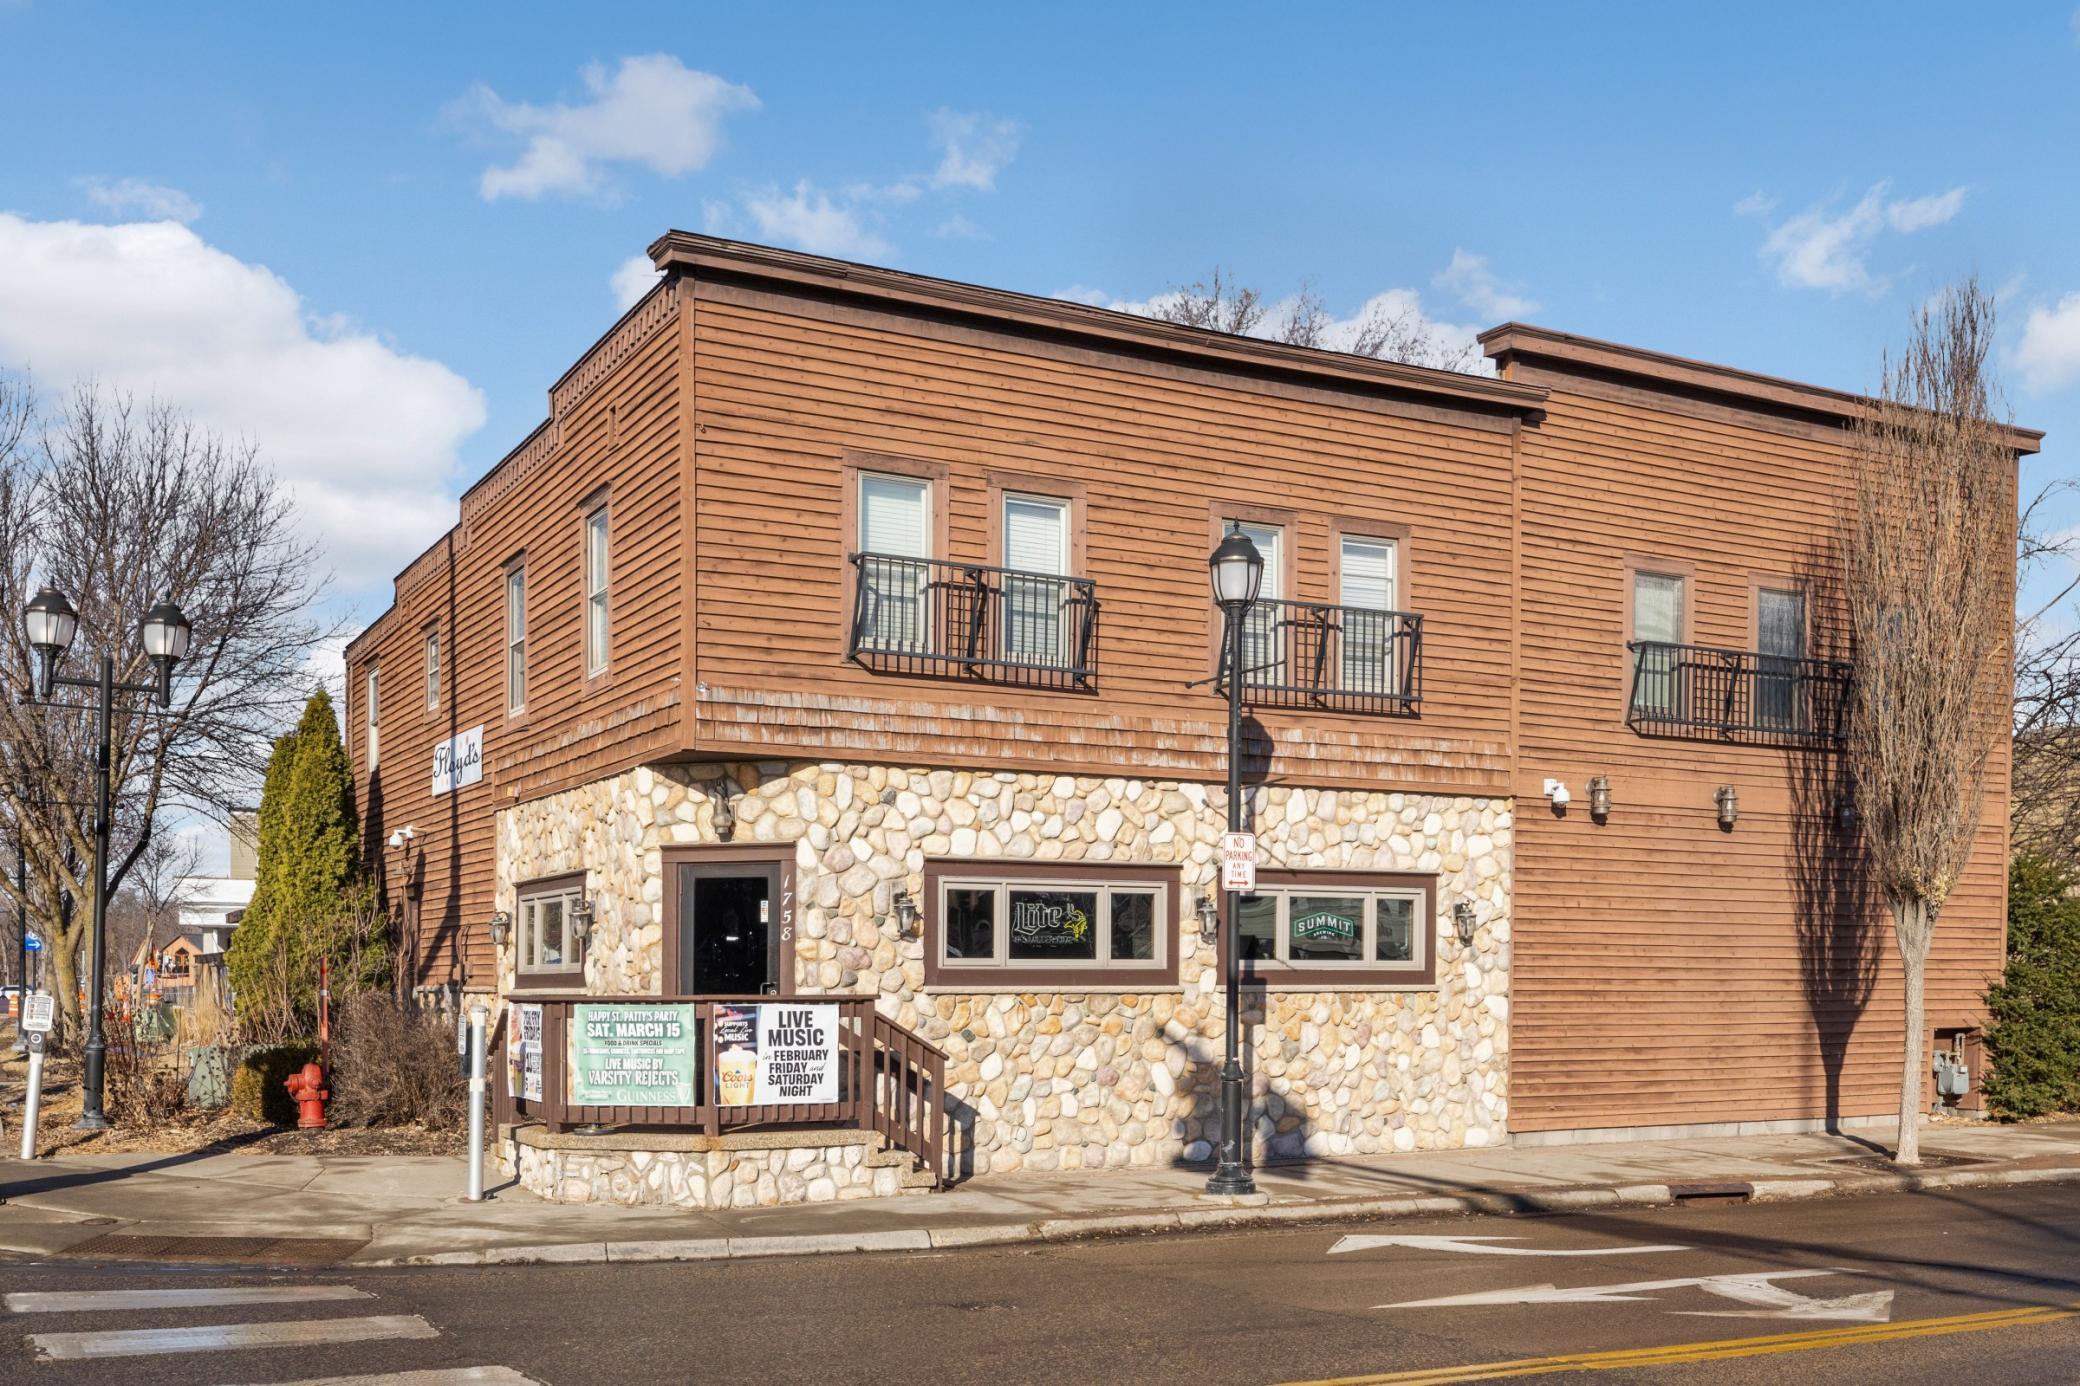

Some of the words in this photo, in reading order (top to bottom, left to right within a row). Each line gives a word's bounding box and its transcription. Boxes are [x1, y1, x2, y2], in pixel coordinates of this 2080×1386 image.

[433, 741, 481, 784] Floyd's
[1233, 837, 1245, 848] NO
[1226, 850, 1253, 862] PARKING
[1232, 863, 1246, 872] ANY
[1231, 871, 1247, 879] TIME
[1014, 902, 1062, 936] Lite
[1298, 915, 1351, 932] SUMMIT
[588, 1011, 609, 1022] HAPPY
[612, 1011, 622, 1021] ST.
[624, 1011, 653, 1022] PATTY'S
[654, 1011, 678, 1021] PARTY
[778, 1010, 814, 1029] LIVE
[587, 1023, 613, 1037] SAT.
[616, 1023, 664, 1037] MARCH
[667, 1023, 681, 1037] 15
[724, 1033, 749, 1041] MUSIC
[768, 1028, 825, 1047] MUSIC
[774, 1049, 829, 1062] FEBRUARY
[605, 1058, 622, 1070] LIVE
[623, 1058, 651, 1070] MUSIC
[652, 1058, 664, 1070] BY
[769, 1062, 808, 1074] FRIDAY
[588, 1071, 631, 1085] VARSITY
[635, 1071, 679, 1087] REJECTS
[722, 1071, 753, 1082] Coors
[768, 1073, 824, 1086] SATURDAY
[779, 1085, 813, 1097] NIGHT
